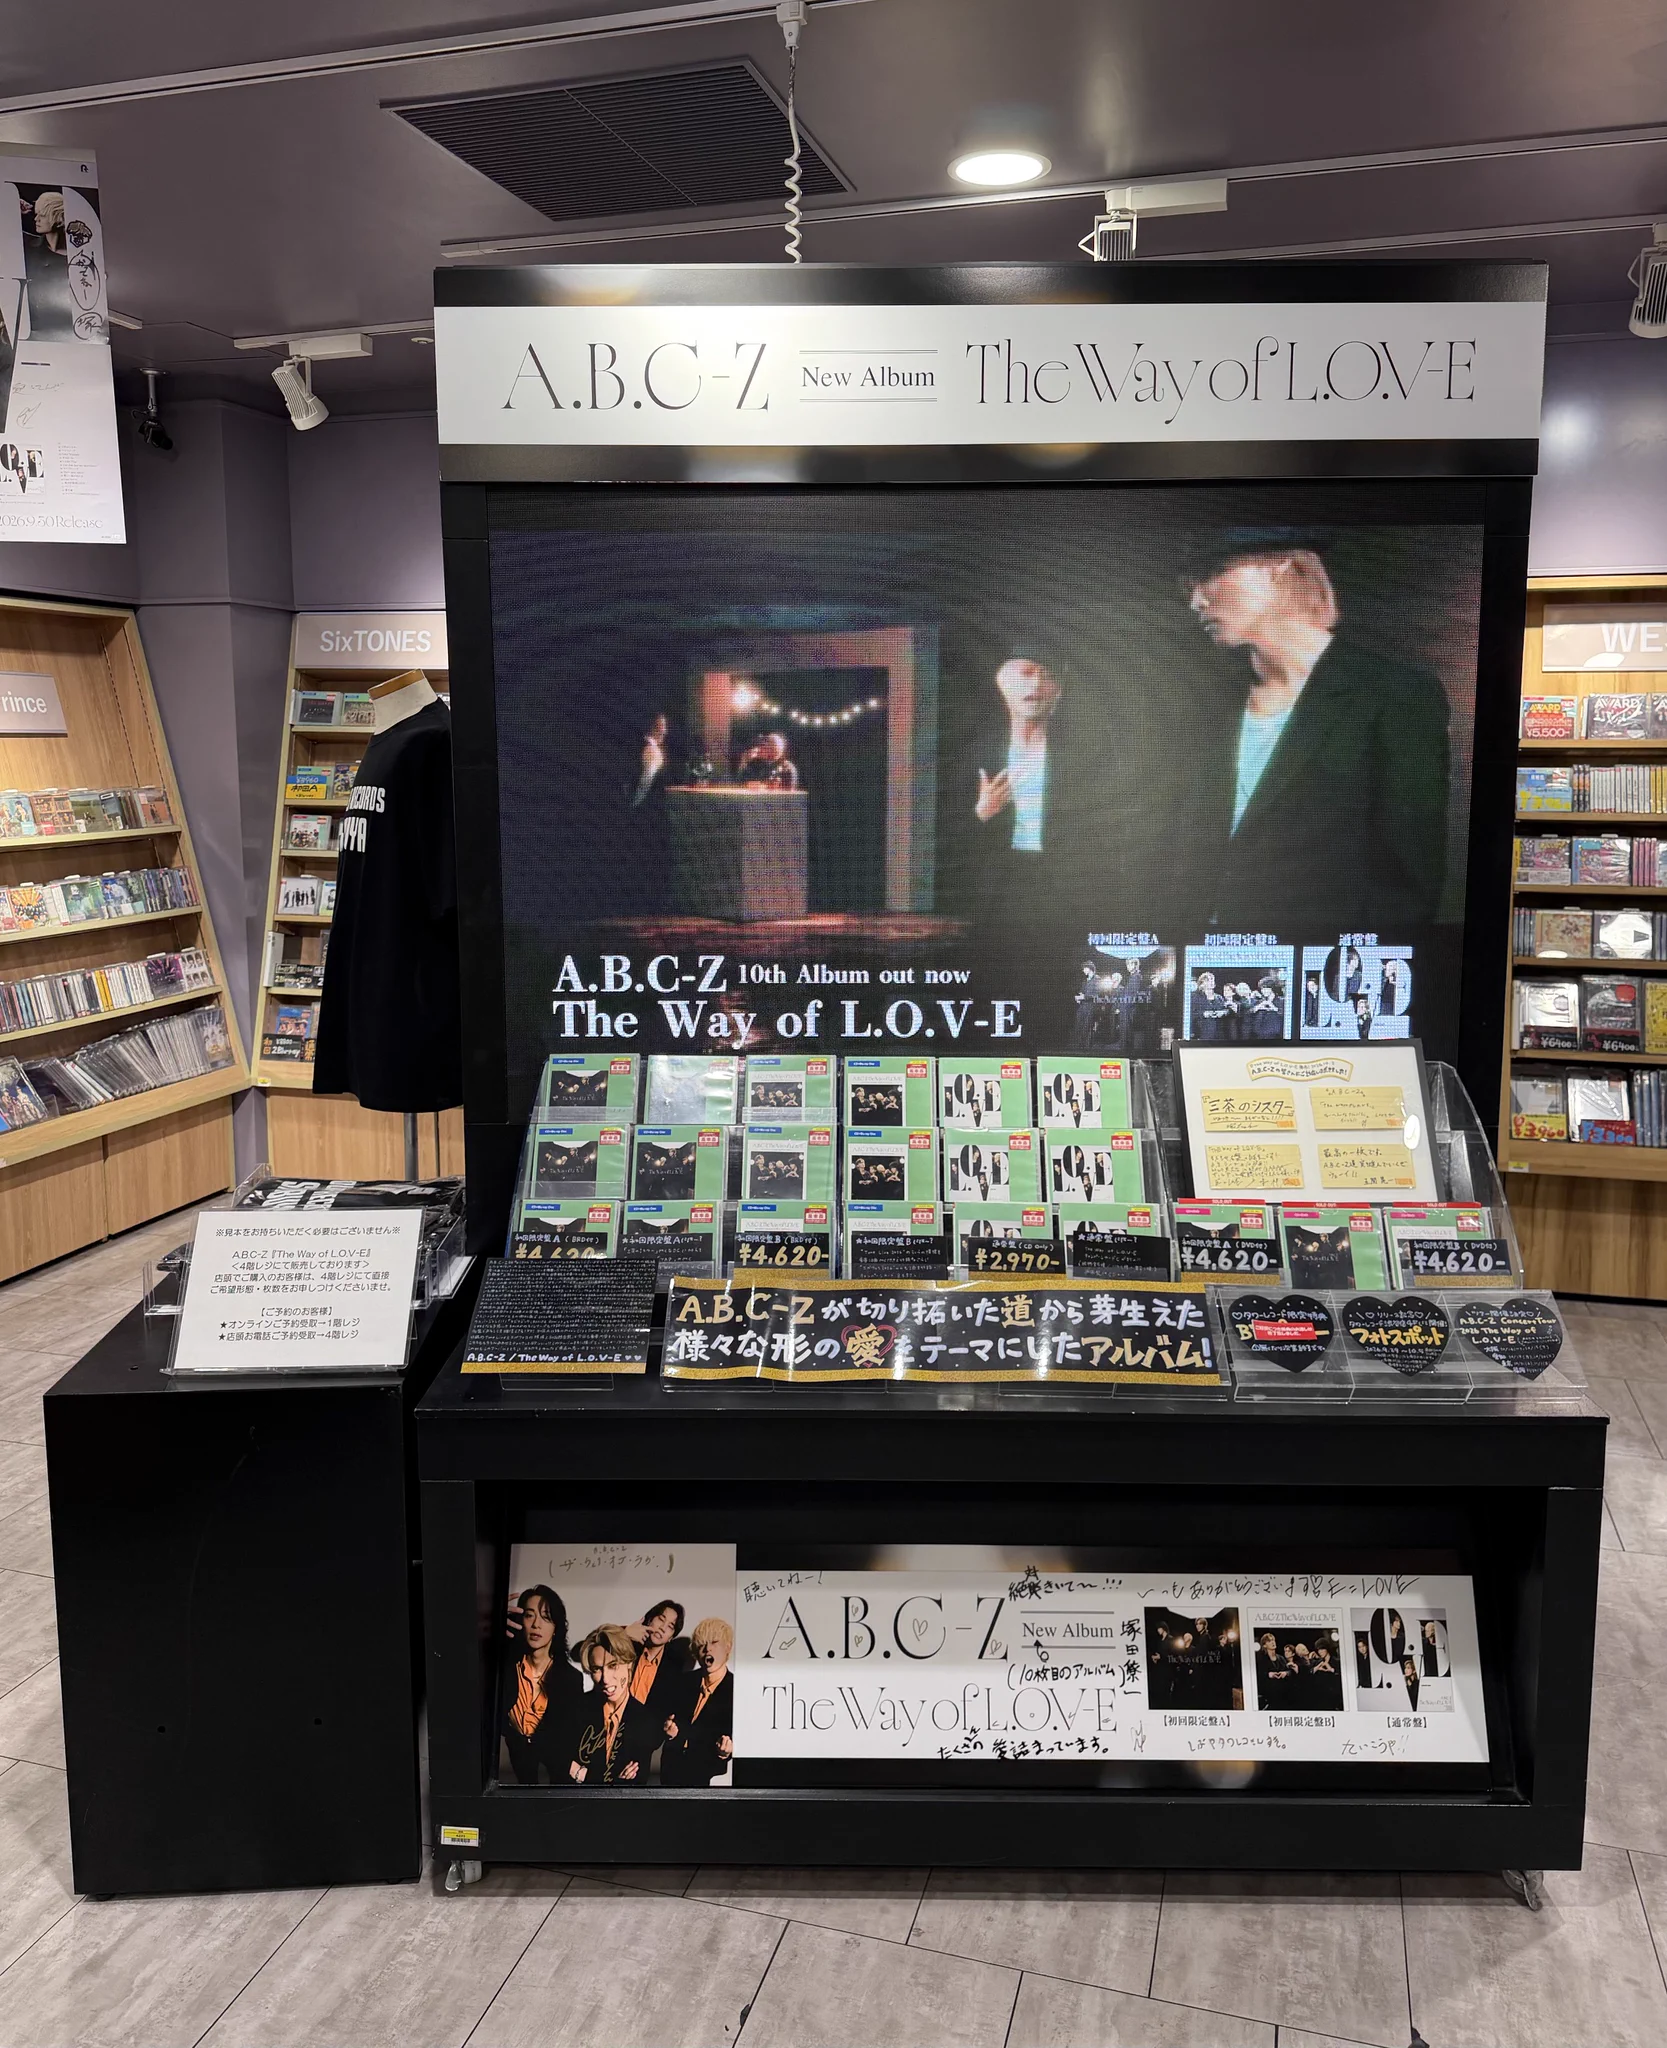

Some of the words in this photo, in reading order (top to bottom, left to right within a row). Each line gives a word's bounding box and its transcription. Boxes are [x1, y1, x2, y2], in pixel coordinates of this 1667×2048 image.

[501, 342, 769, 411] A.B.C-Z
[802, 366, 852, 388] New
[861, 365, 936, 388] Album
[966, 339, 1070, 404] The
[1074, 342, 1203, 425] Way
[1209, 335, 1280, 402] of
[1286, 338, 1476, 403] L.O.V-E
[320, 630, 431, 652] SixTONES
[1601, 622, 1667, 653] WE
[552, 955, 728, 993] A.B.C-Z
[738, 964, 787, 984] 10th
[797, 964, 870, 984] Album
[879, 966, 915, 984] out
[925, 969, 971, 984] now
[552, 999, 638, 1038] The
[658, 1000, 757, 1050] Way
[777, 999, 823, 1038] of
[841, 1000, 1022, 1038] L.O.V-E
[297, 1250, 316, 1260] Way
[318, 1249, 329, 1258] of
[261, 1306, 332, 1317] 【ご予約のお客様】
[1349, 1325, 1445, 1345] フォトスポット
[1500, 1327, 1522, 1335] Way
[1525, 1326, 1537, 1334] of
[467, 1353, 506, 1362] A.B.C-Z
[538, 1354, 559, 1363] Way
[562, 1353, 574, 1361] of
[577, 1353, 621, 1362] L.O.V-E
[762, 1593, 1009, 1660] A.B.C-Z
[1022, 1623, 1057, 1637] New
[1062, 1623, 1114, 1638] Album
[762, 1682, 836, 1730] The
[837, 1687, 926, 1747] Way
[931, 1682, 979, 1731] of
[984, 1686, 1118, 1733] L.O.V-E
[1163, 1715, 1231, 1728] 【初回限定盤A】
[1268, 1716, 1336, 1729] 【初回限定盤B】
[1386, 1716, 1428, 1729] 【通常盤】
